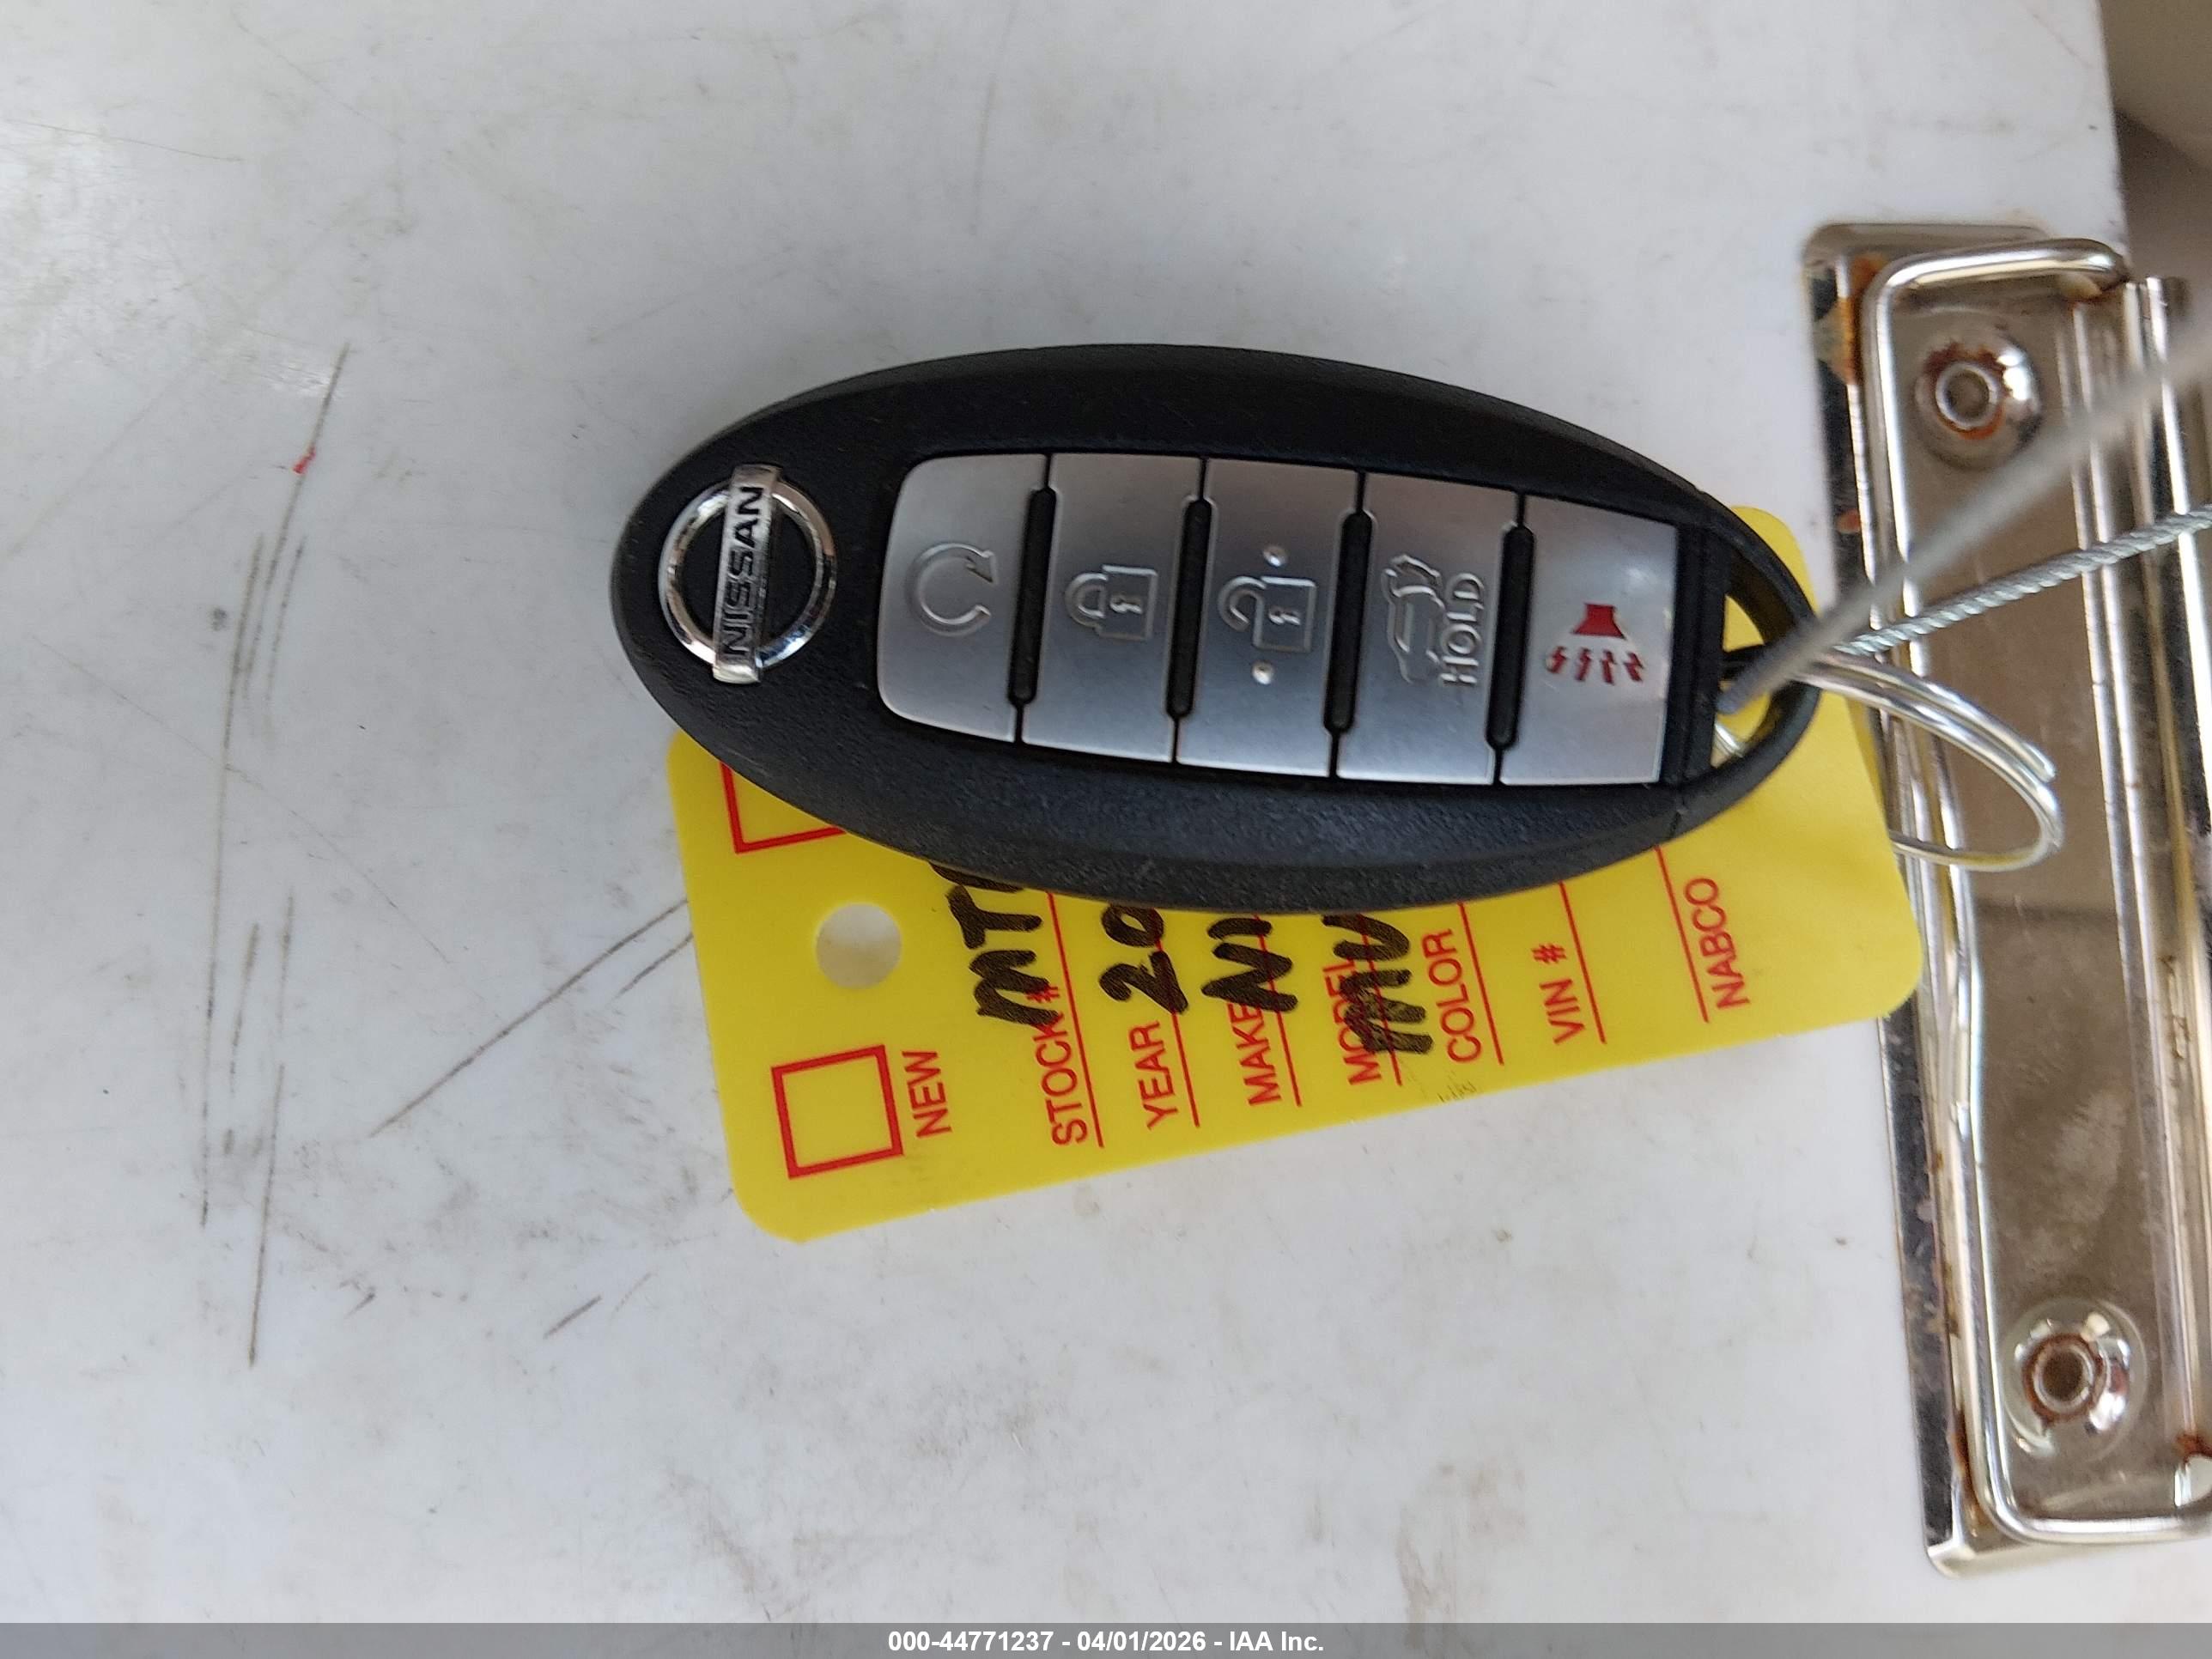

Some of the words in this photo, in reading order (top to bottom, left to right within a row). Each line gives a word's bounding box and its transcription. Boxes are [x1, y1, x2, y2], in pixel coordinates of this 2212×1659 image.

[721, 485, 765, 658] NISSAN
[1438, 572, 1486, 685] HOLD
[928, 861, 1060, 1027] MT
[1422, 927, 1482, 1064] COLOR
[1532, 941, 1568, 963] #
[1686, 878, 1751, 1010] NABCO
[1225, 1000, 1282, 1107] MAKE
[1544, 977, 1586, 1045] VIN
[902, 1050, 952, 1139] NEW
[1030, 1011, 1088, 1147] STOCK
[1127, 1019, 1180, 1131] YEAR
